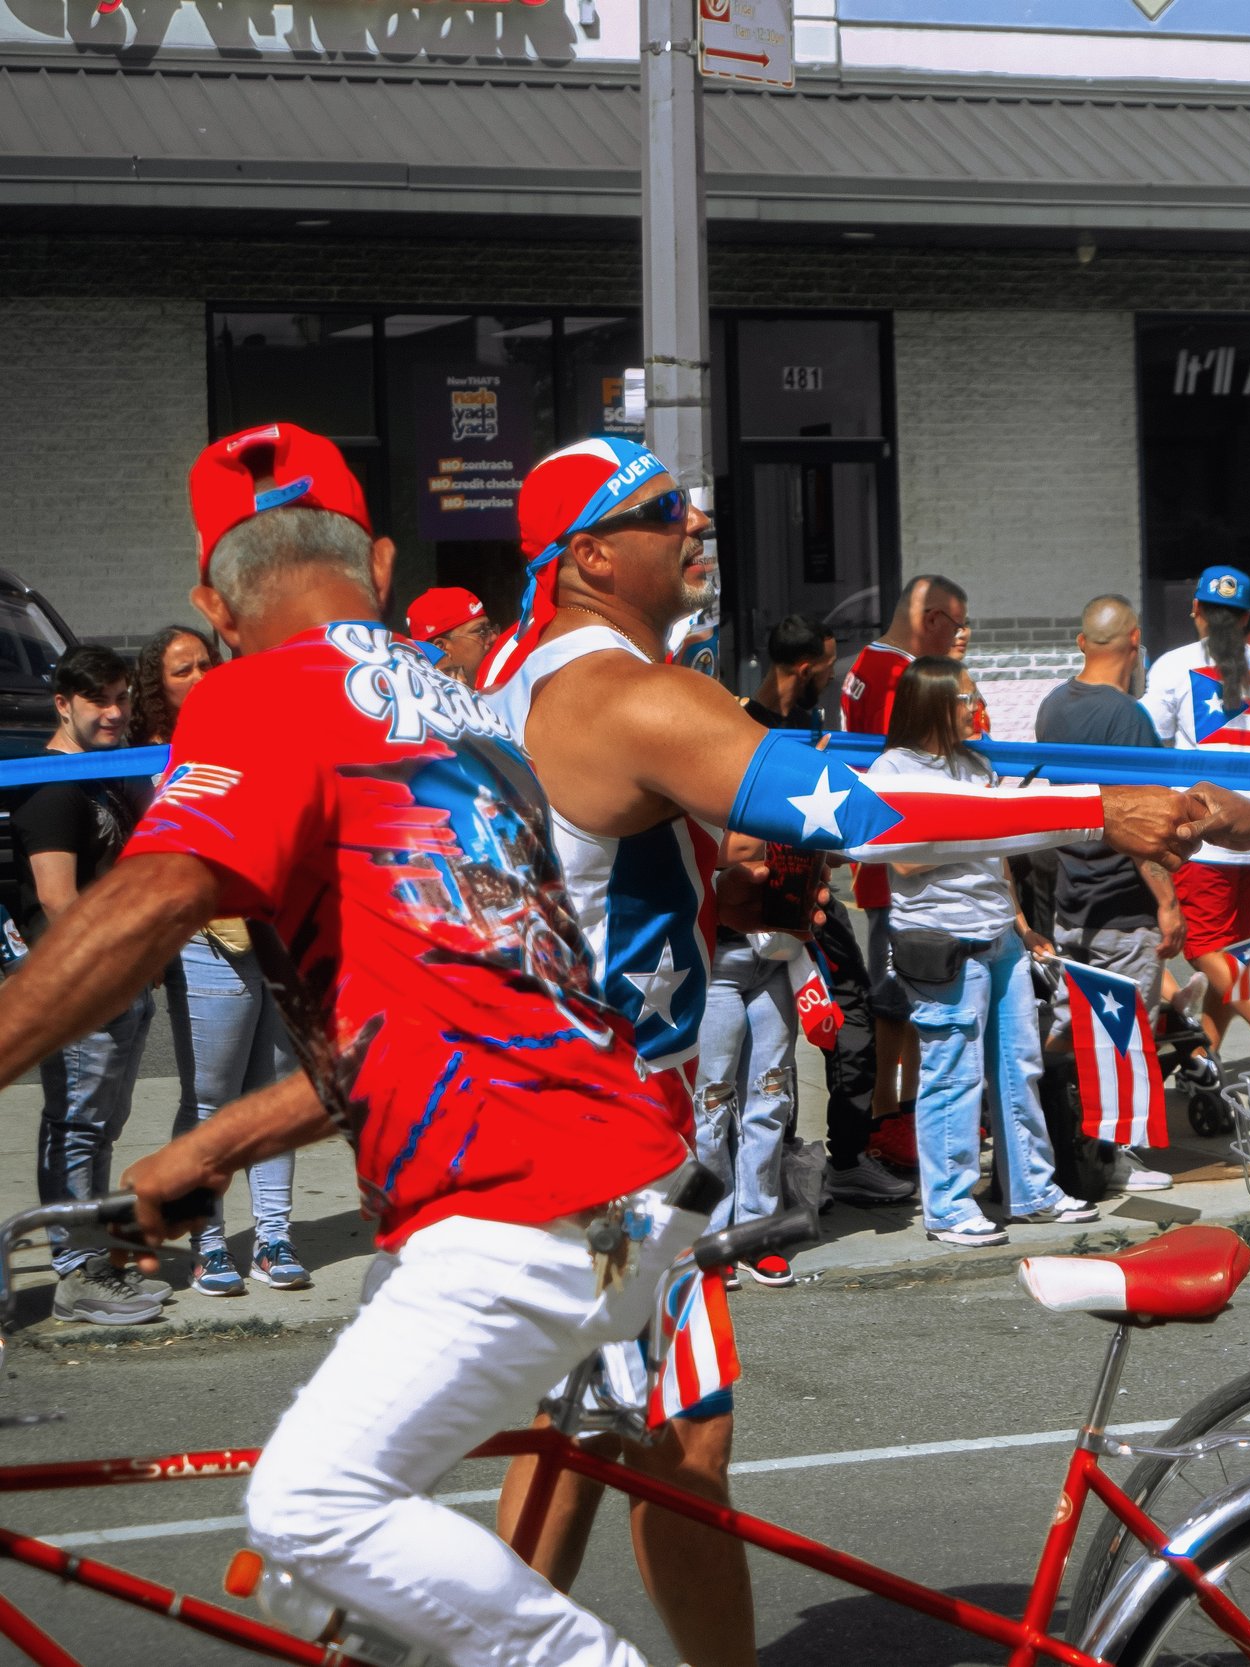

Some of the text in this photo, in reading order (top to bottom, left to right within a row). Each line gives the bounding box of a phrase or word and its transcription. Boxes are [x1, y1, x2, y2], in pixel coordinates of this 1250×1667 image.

[784, 367, 820, 389] 481
[1174, 347, 1235, 395] It'll
[446, 376, 467, 386] Now
[452, 388, 497, 405] nada
[453, 404, 497, 422] yada
[441, 459, 514, 471] NO contracts
[606, 453, 661, 496] PUERT
[430, 479, 450, 489] NO
[452, 478, 485, 490] credit
[442, 496, 514, 510] NO surprises
